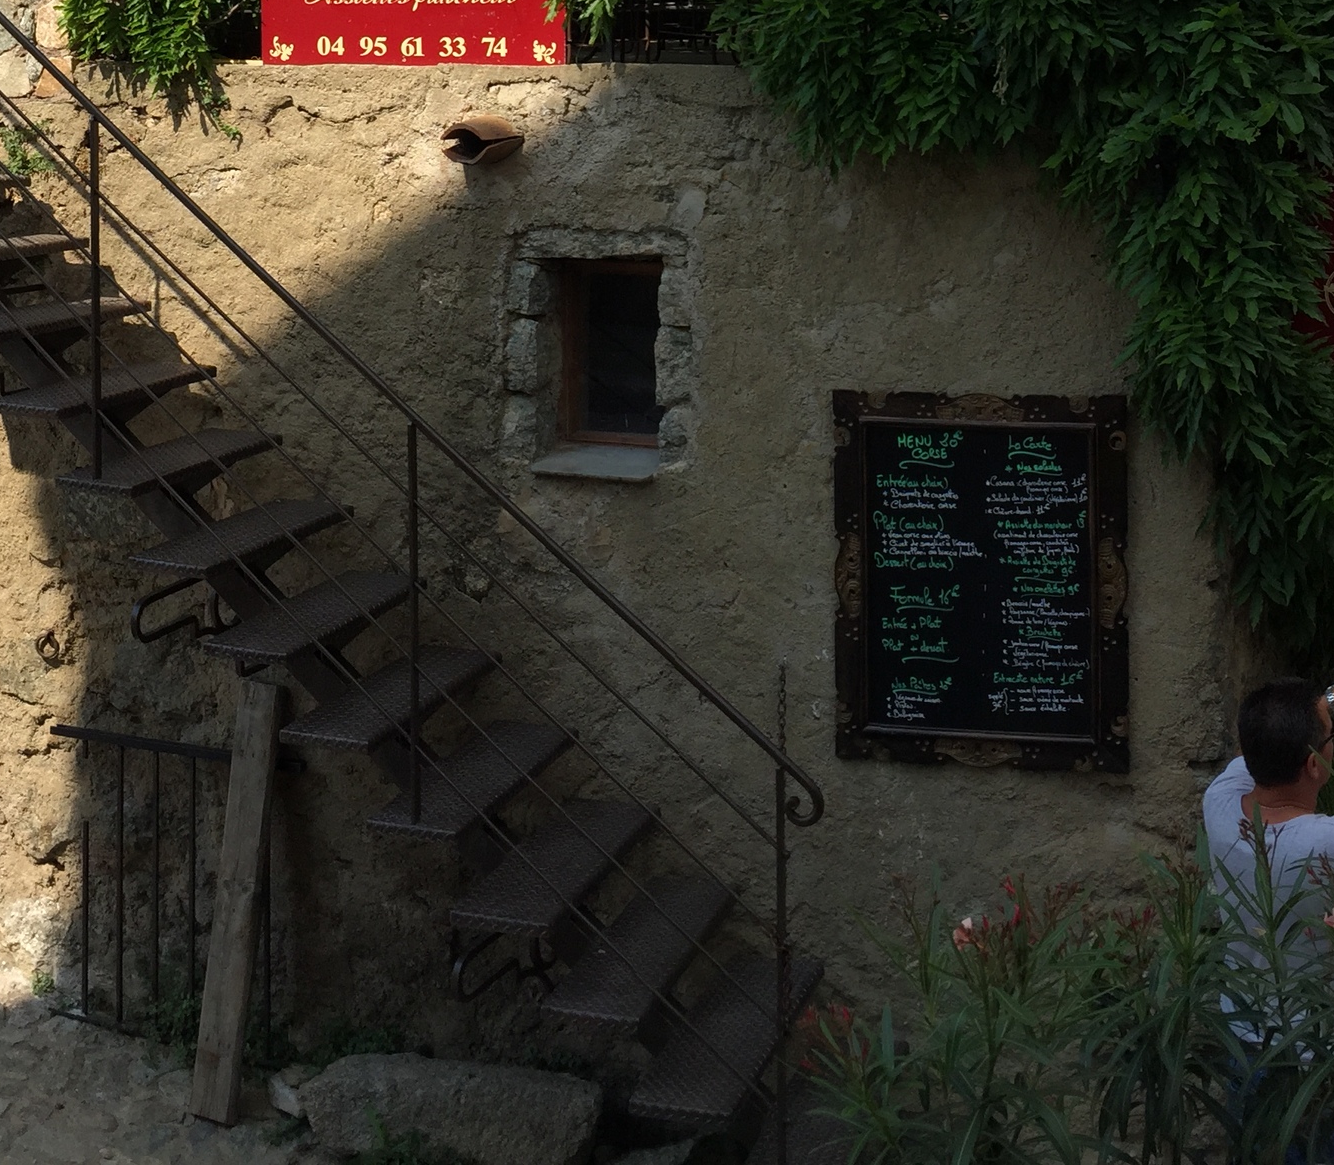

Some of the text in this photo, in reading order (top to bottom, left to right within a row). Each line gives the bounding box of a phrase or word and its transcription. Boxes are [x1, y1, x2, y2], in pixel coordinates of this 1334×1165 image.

[316, 35, 508, 58] 04 95 61 33 74
[897, 433, 932, 449] MENU
[911, 447, 948, 460] CORSE
[873, 510, 897, 530] Plat
[889, 584, 935, 606] Formule
[918, 614, 942, 628] Plat
[881, 638, 905, 651] Plat
